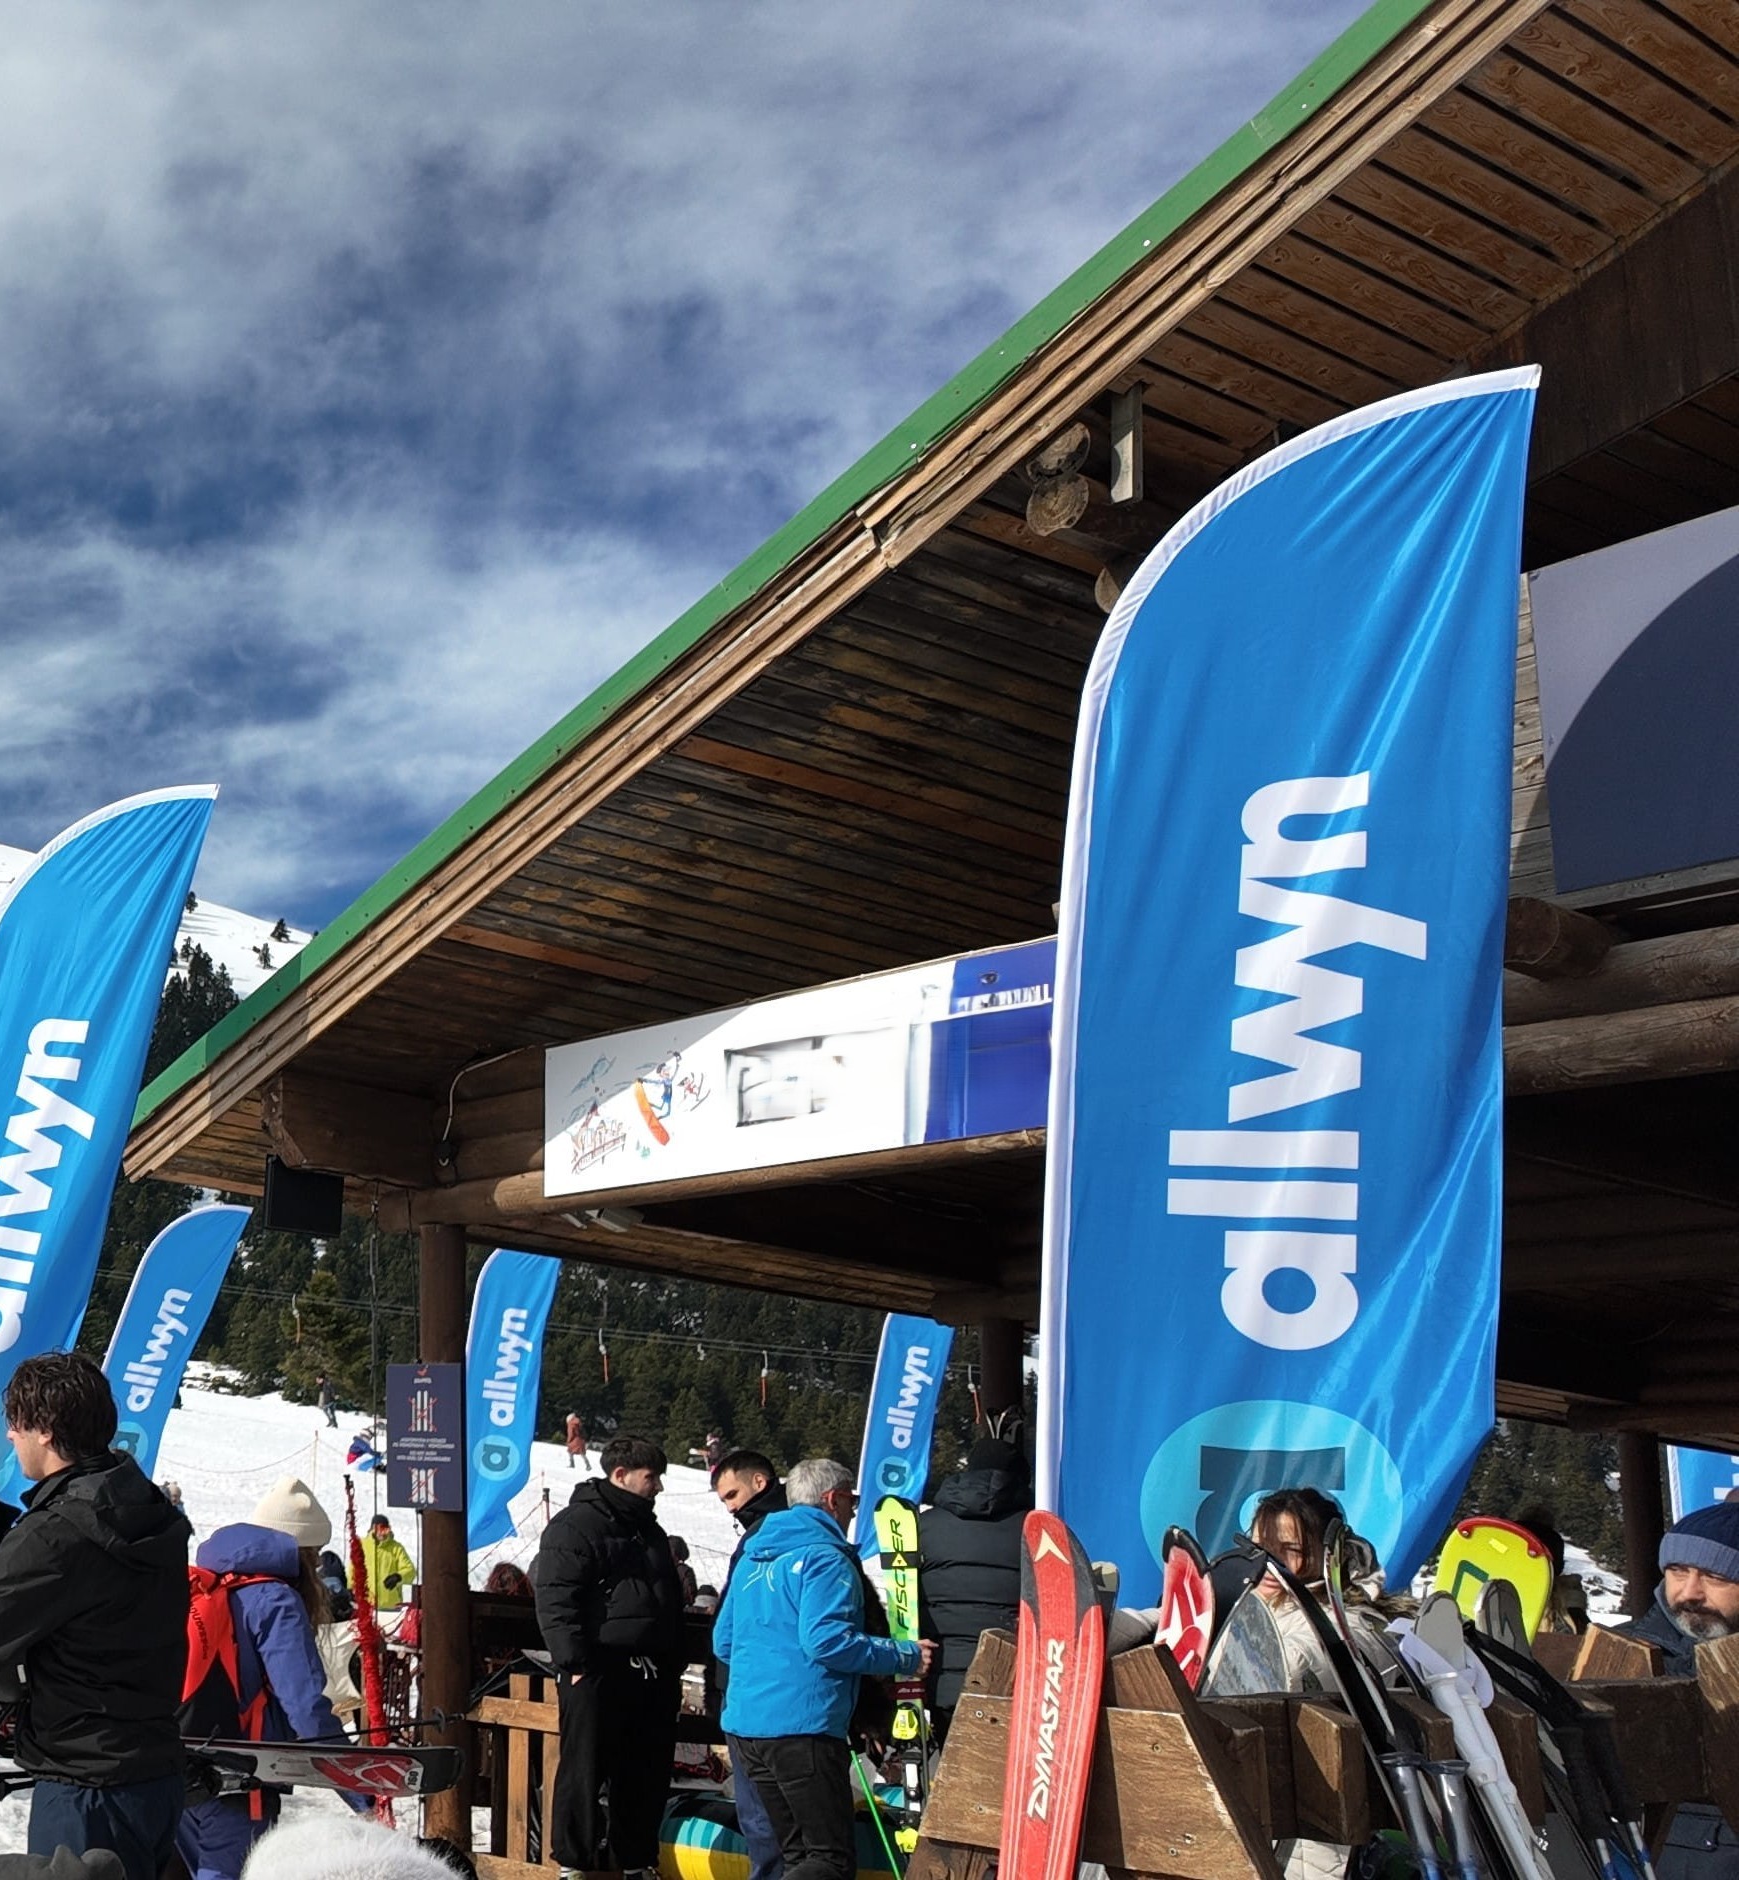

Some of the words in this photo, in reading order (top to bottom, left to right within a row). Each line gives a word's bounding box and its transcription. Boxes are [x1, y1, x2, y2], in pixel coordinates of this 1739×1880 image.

[1166, 770, 1427, 1351] allwyn
[122, 1287, 193, 1413] allwyn
[482, 1307, 533, 1427] allwyn
[886, 1345, 934, 1450] allwyn
[889, 1518, 909, 1631] FISCER
[1026, 1638, 1066, 1820] DYNASTAR
